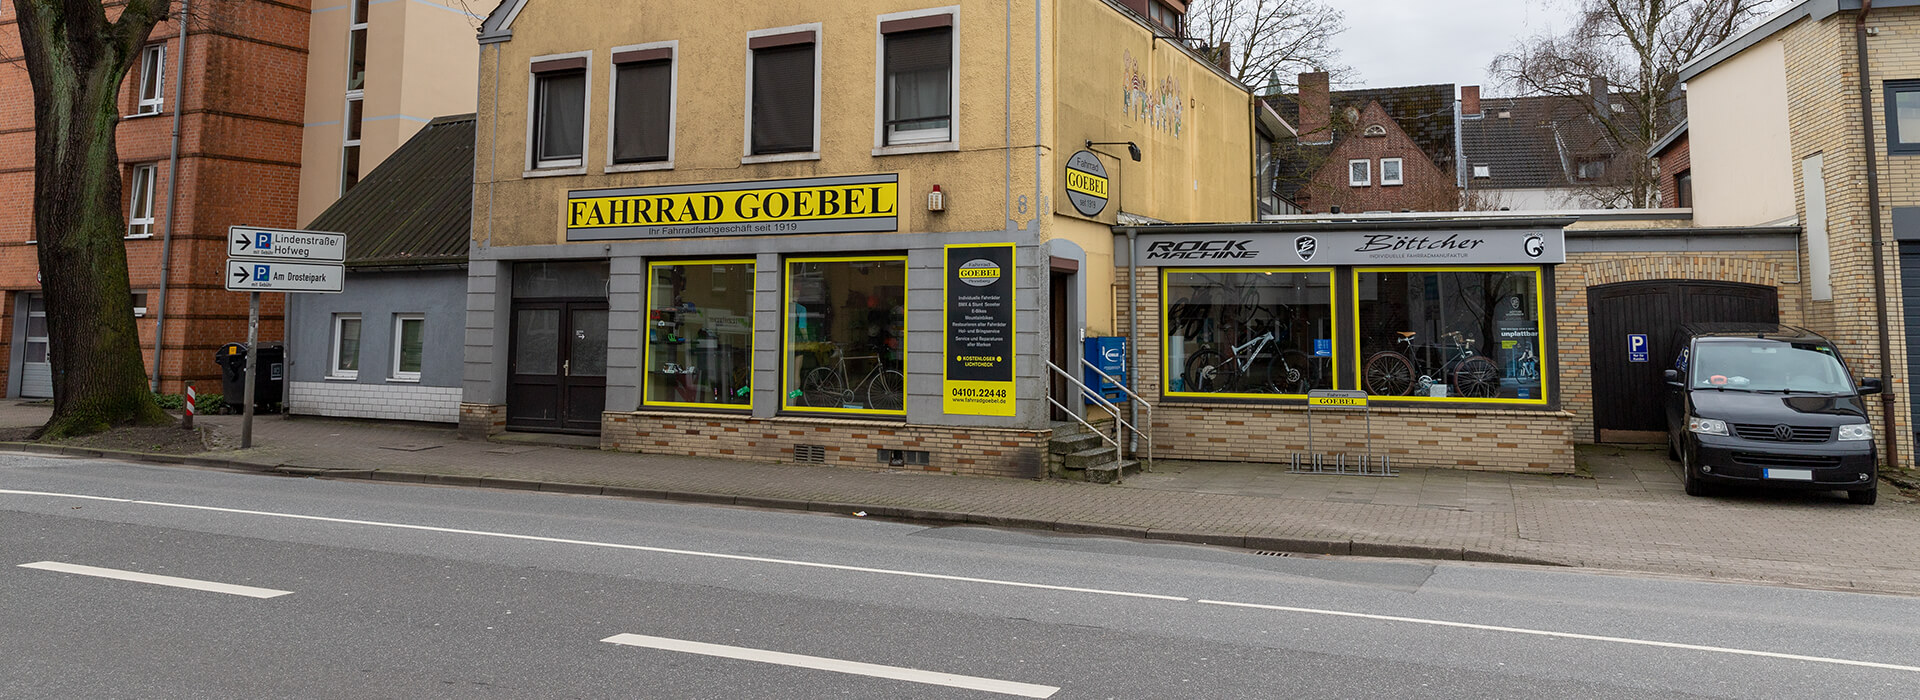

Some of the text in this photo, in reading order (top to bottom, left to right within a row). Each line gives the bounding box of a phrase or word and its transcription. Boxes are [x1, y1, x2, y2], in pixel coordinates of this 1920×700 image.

[1076, 157, 1099, 172] Fahrrad
[1068, 172, 1106, 195] GOEBEL
[570, 186, 894, 226] FAHRRAD GOEBEL
[1018, 194, 1027, 214] 8
[649, 222, 797, 235] Ihr Fahrradfachgeschäft seit 1919
[259, 234, 268, 247] P
[275, 234, 339, 246] Lindenstraße/
[1147, 240, 1253, 252] ROCK
[1354, 233, 1485, 252] Böttcher
[274, 246, 310, 257] Hofweg
[1147, 251, 1260, 260] MACHINE
[257, 267, 266, 280] P
[273, 271, 327, 284] Am Drosteipark
[960, 269, 999, 277] GOEBEL
[1501, 330, 1539, 338] unplattbar
[1631, 336, 1644, 352] P
